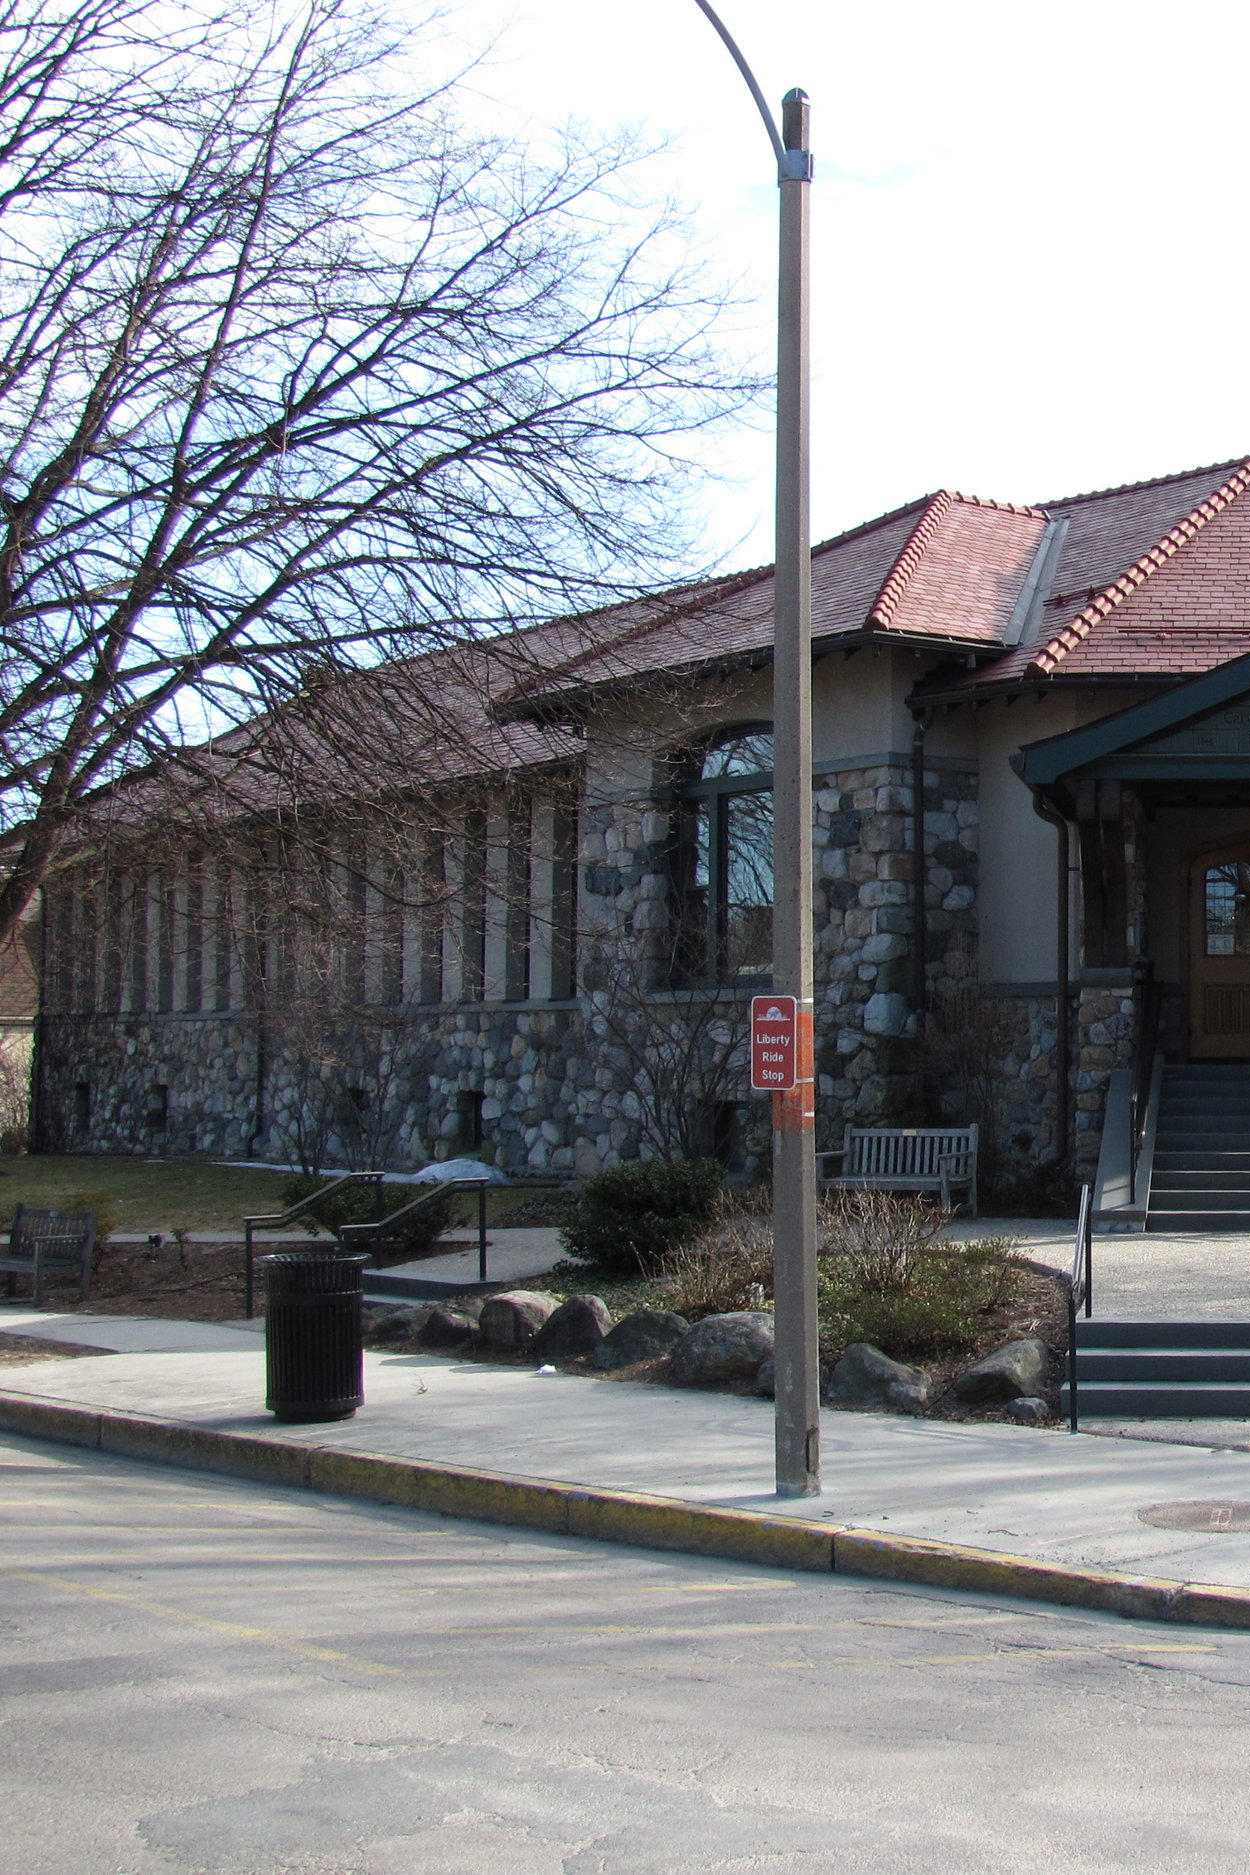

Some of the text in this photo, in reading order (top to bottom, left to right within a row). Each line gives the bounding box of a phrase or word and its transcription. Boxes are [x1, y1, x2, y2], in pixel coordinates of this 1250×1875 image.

[756, 1034, 790, 1047] Liberty
[762, 1051, 784, 1062] Ride
[761, 1069, 785, 1082] Stop
